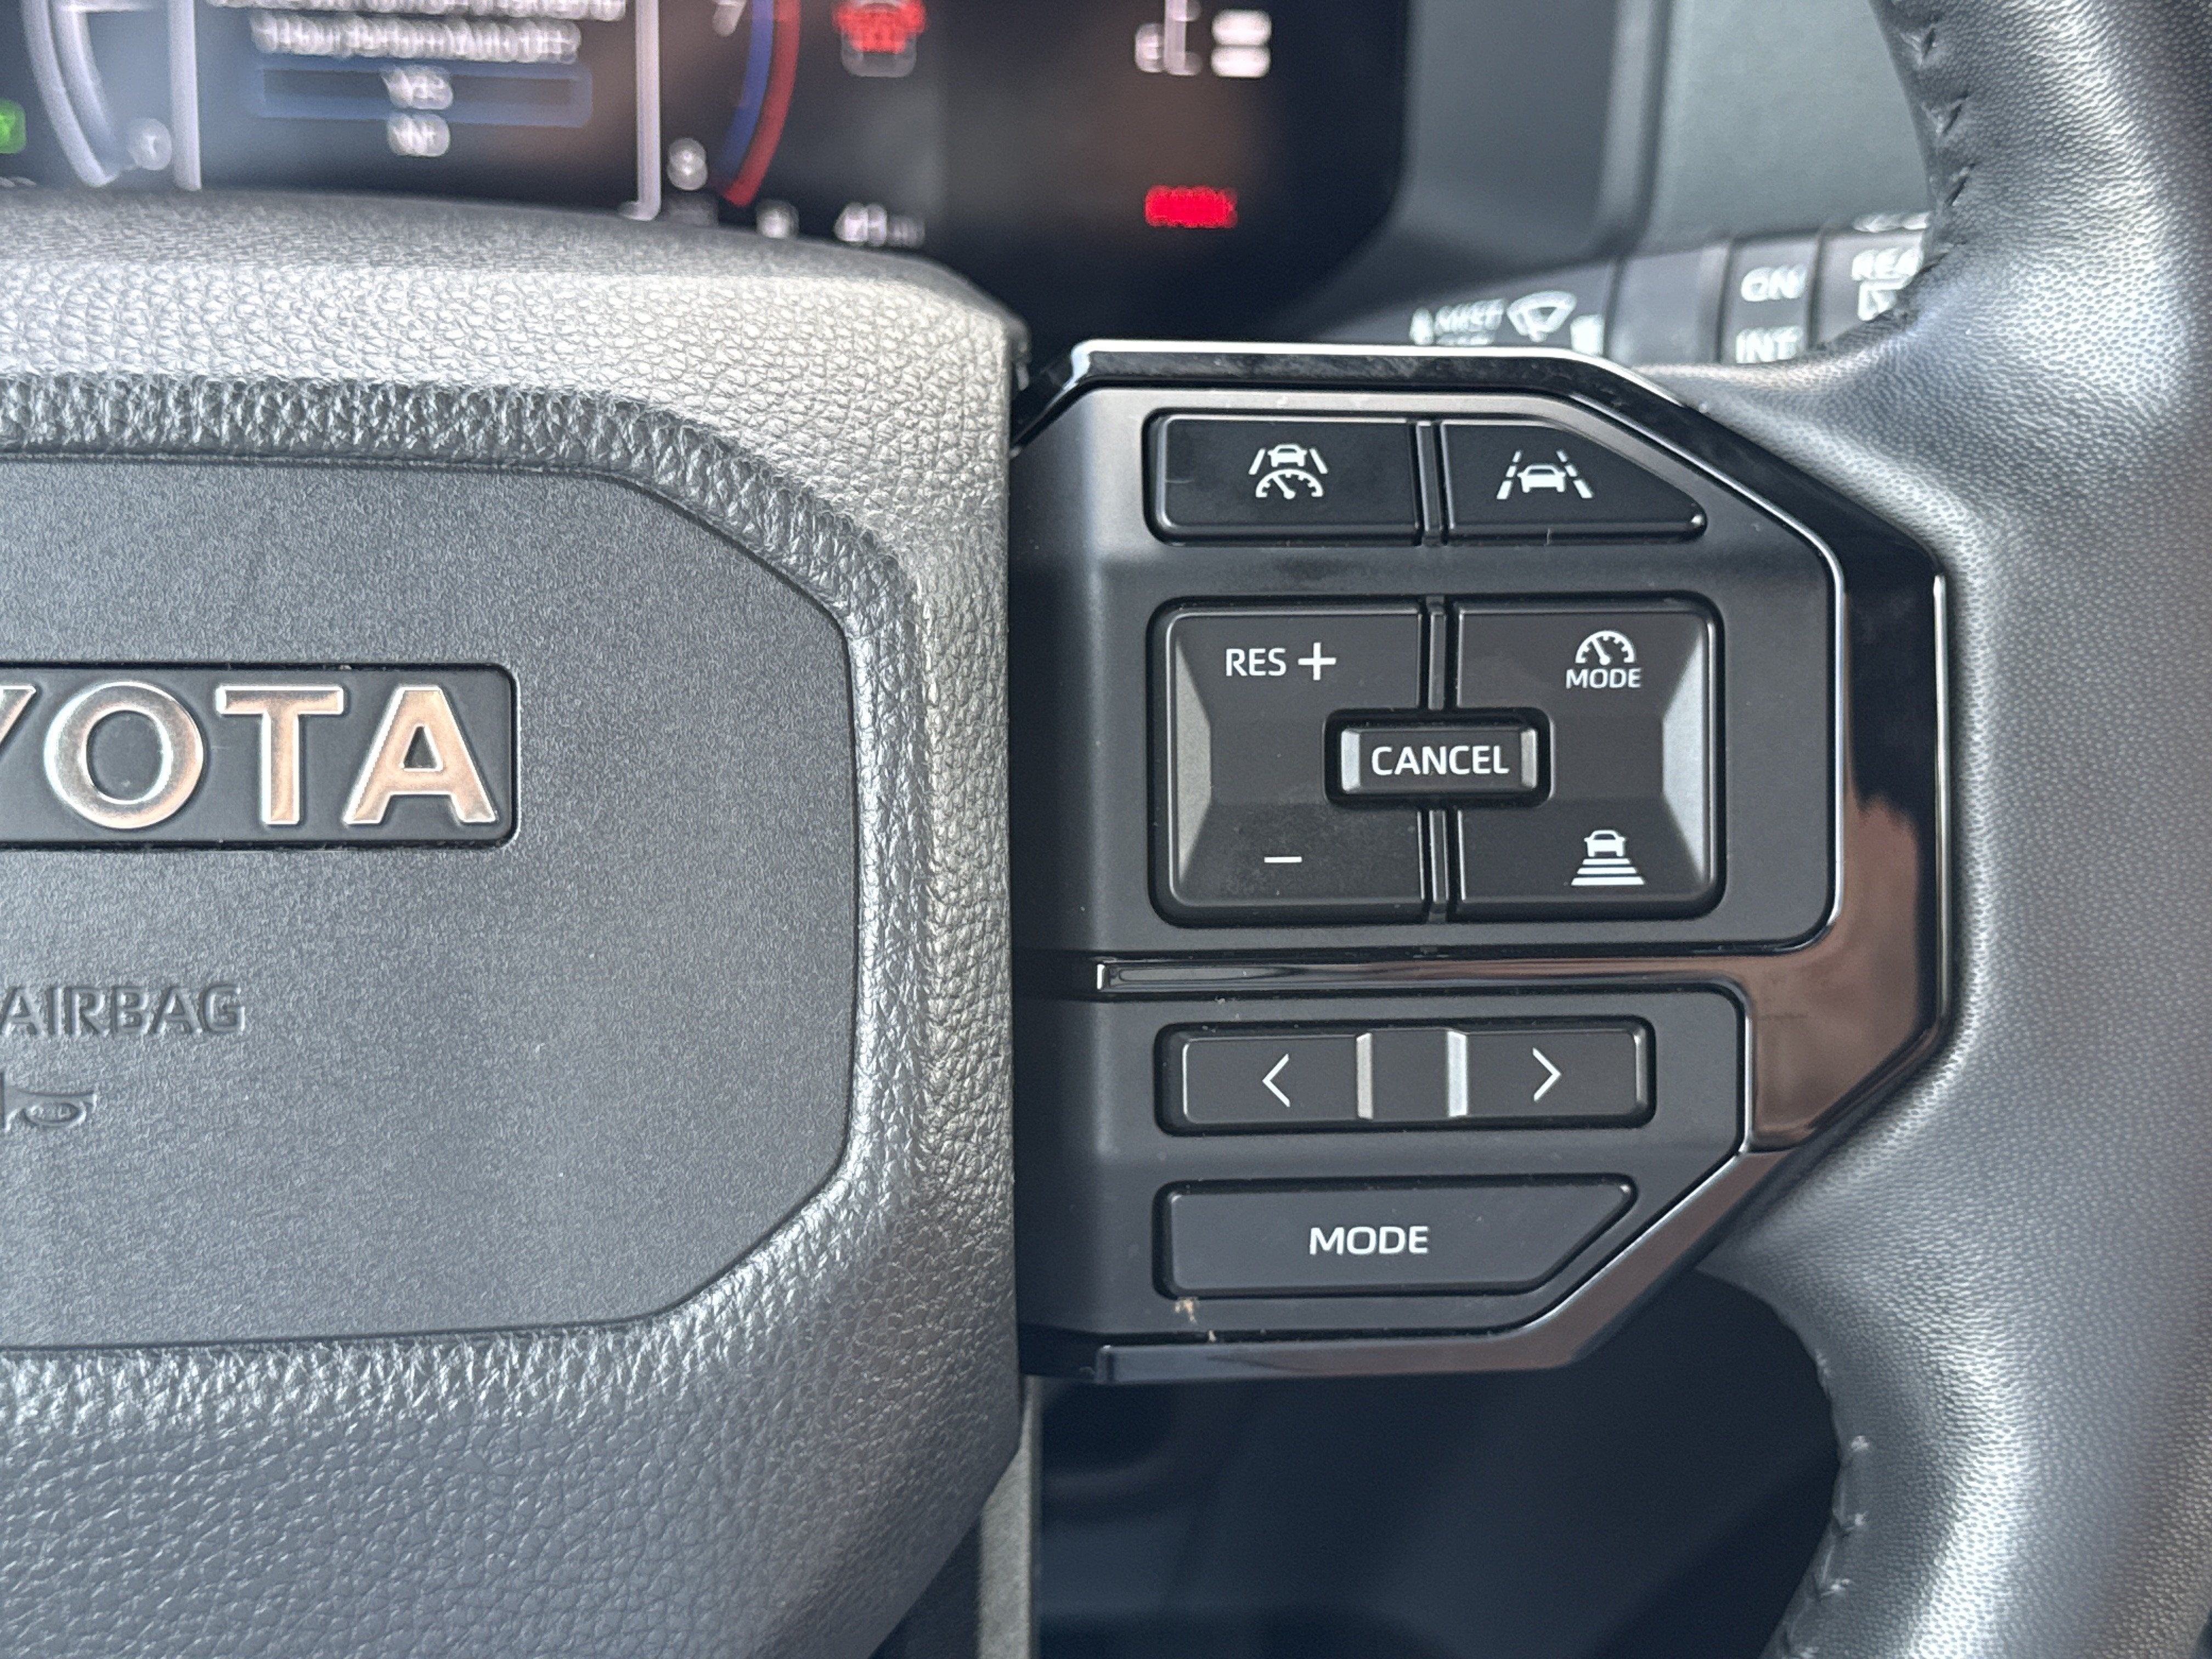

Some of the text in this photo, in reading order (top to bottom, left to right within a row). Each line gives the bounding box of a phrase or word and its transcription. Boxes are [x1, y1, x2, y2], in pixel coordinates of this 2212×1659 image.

[1741, 264, 1807, 301] ON
[1735, 326, 1803, 363] INT
[1226, 647, 1286, 676] RES
[1565, 668, 1641, 689] MODE
[0, 681, 498, 829] OTA
[1371, 745, 1509, 776] CANCEL
[0, 985, 245, 1036] AIRBAG
[1309, 1225, 1429, 1256] MODE
